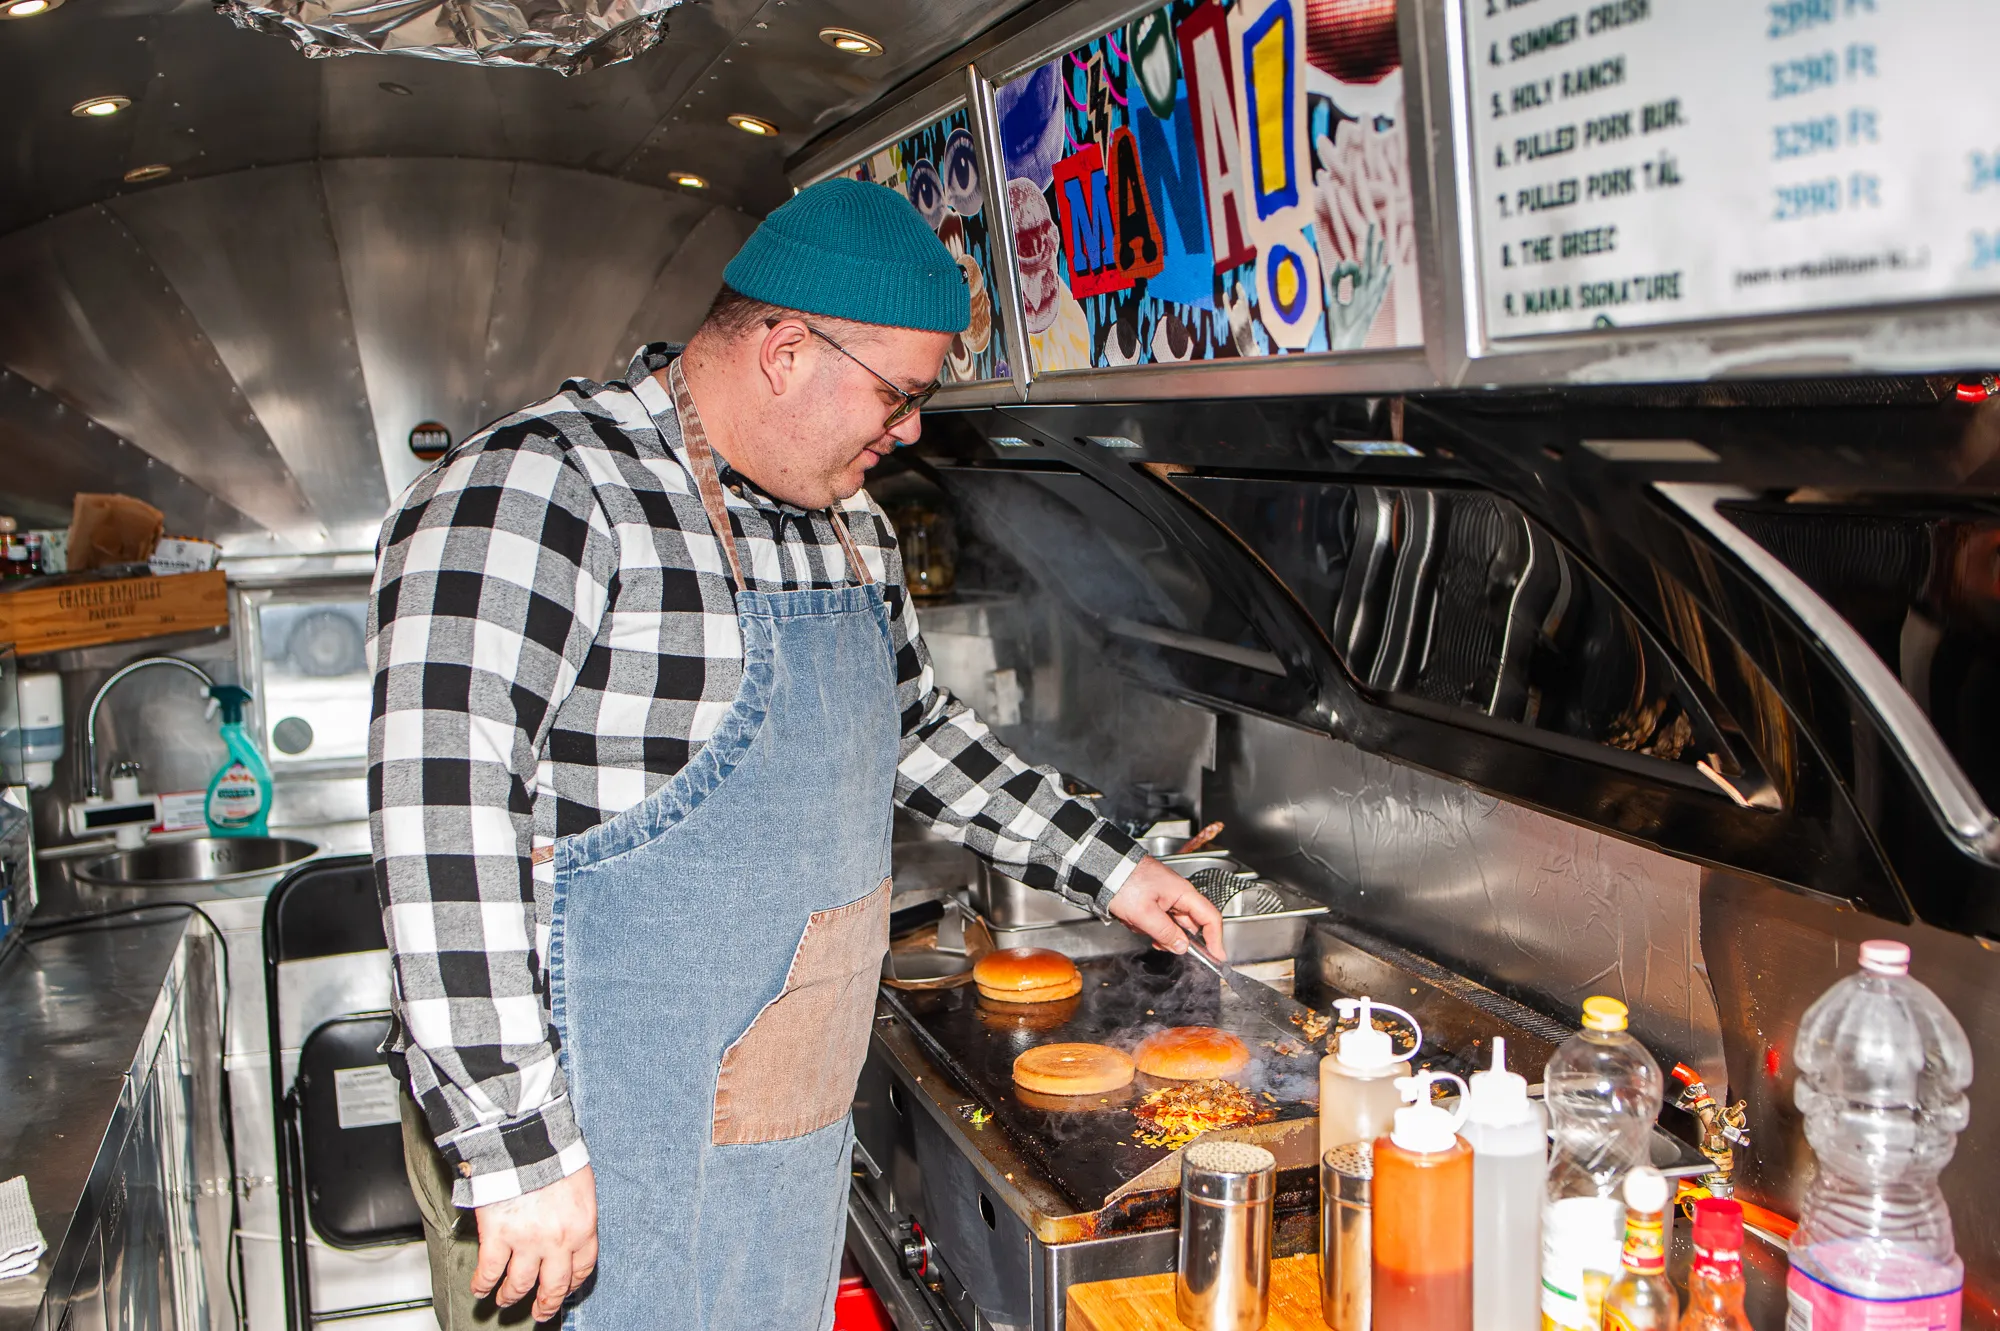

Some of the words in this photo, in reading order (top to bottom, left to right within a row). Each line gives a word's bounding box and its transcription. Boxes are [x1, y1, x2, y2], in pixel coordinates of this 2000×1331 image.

[1509, 14, 1578, 62] SUMMER
[1587, 0, 1651, 36] CRUSH
[1511, 77, 1554, 113] HOLY
[1560, 54, 1626, 98] RANCH
[1514, 124, 1576, 163] PULLED
[1585, 109, 1633, 147] PORK
[1517, 177, 1579, 213] PULLED
[1587, 167, 1635, 203] PORK
[1520, 236, 1554, 265] THE
[1579, 271, 1684, 312] SIGNATURE
